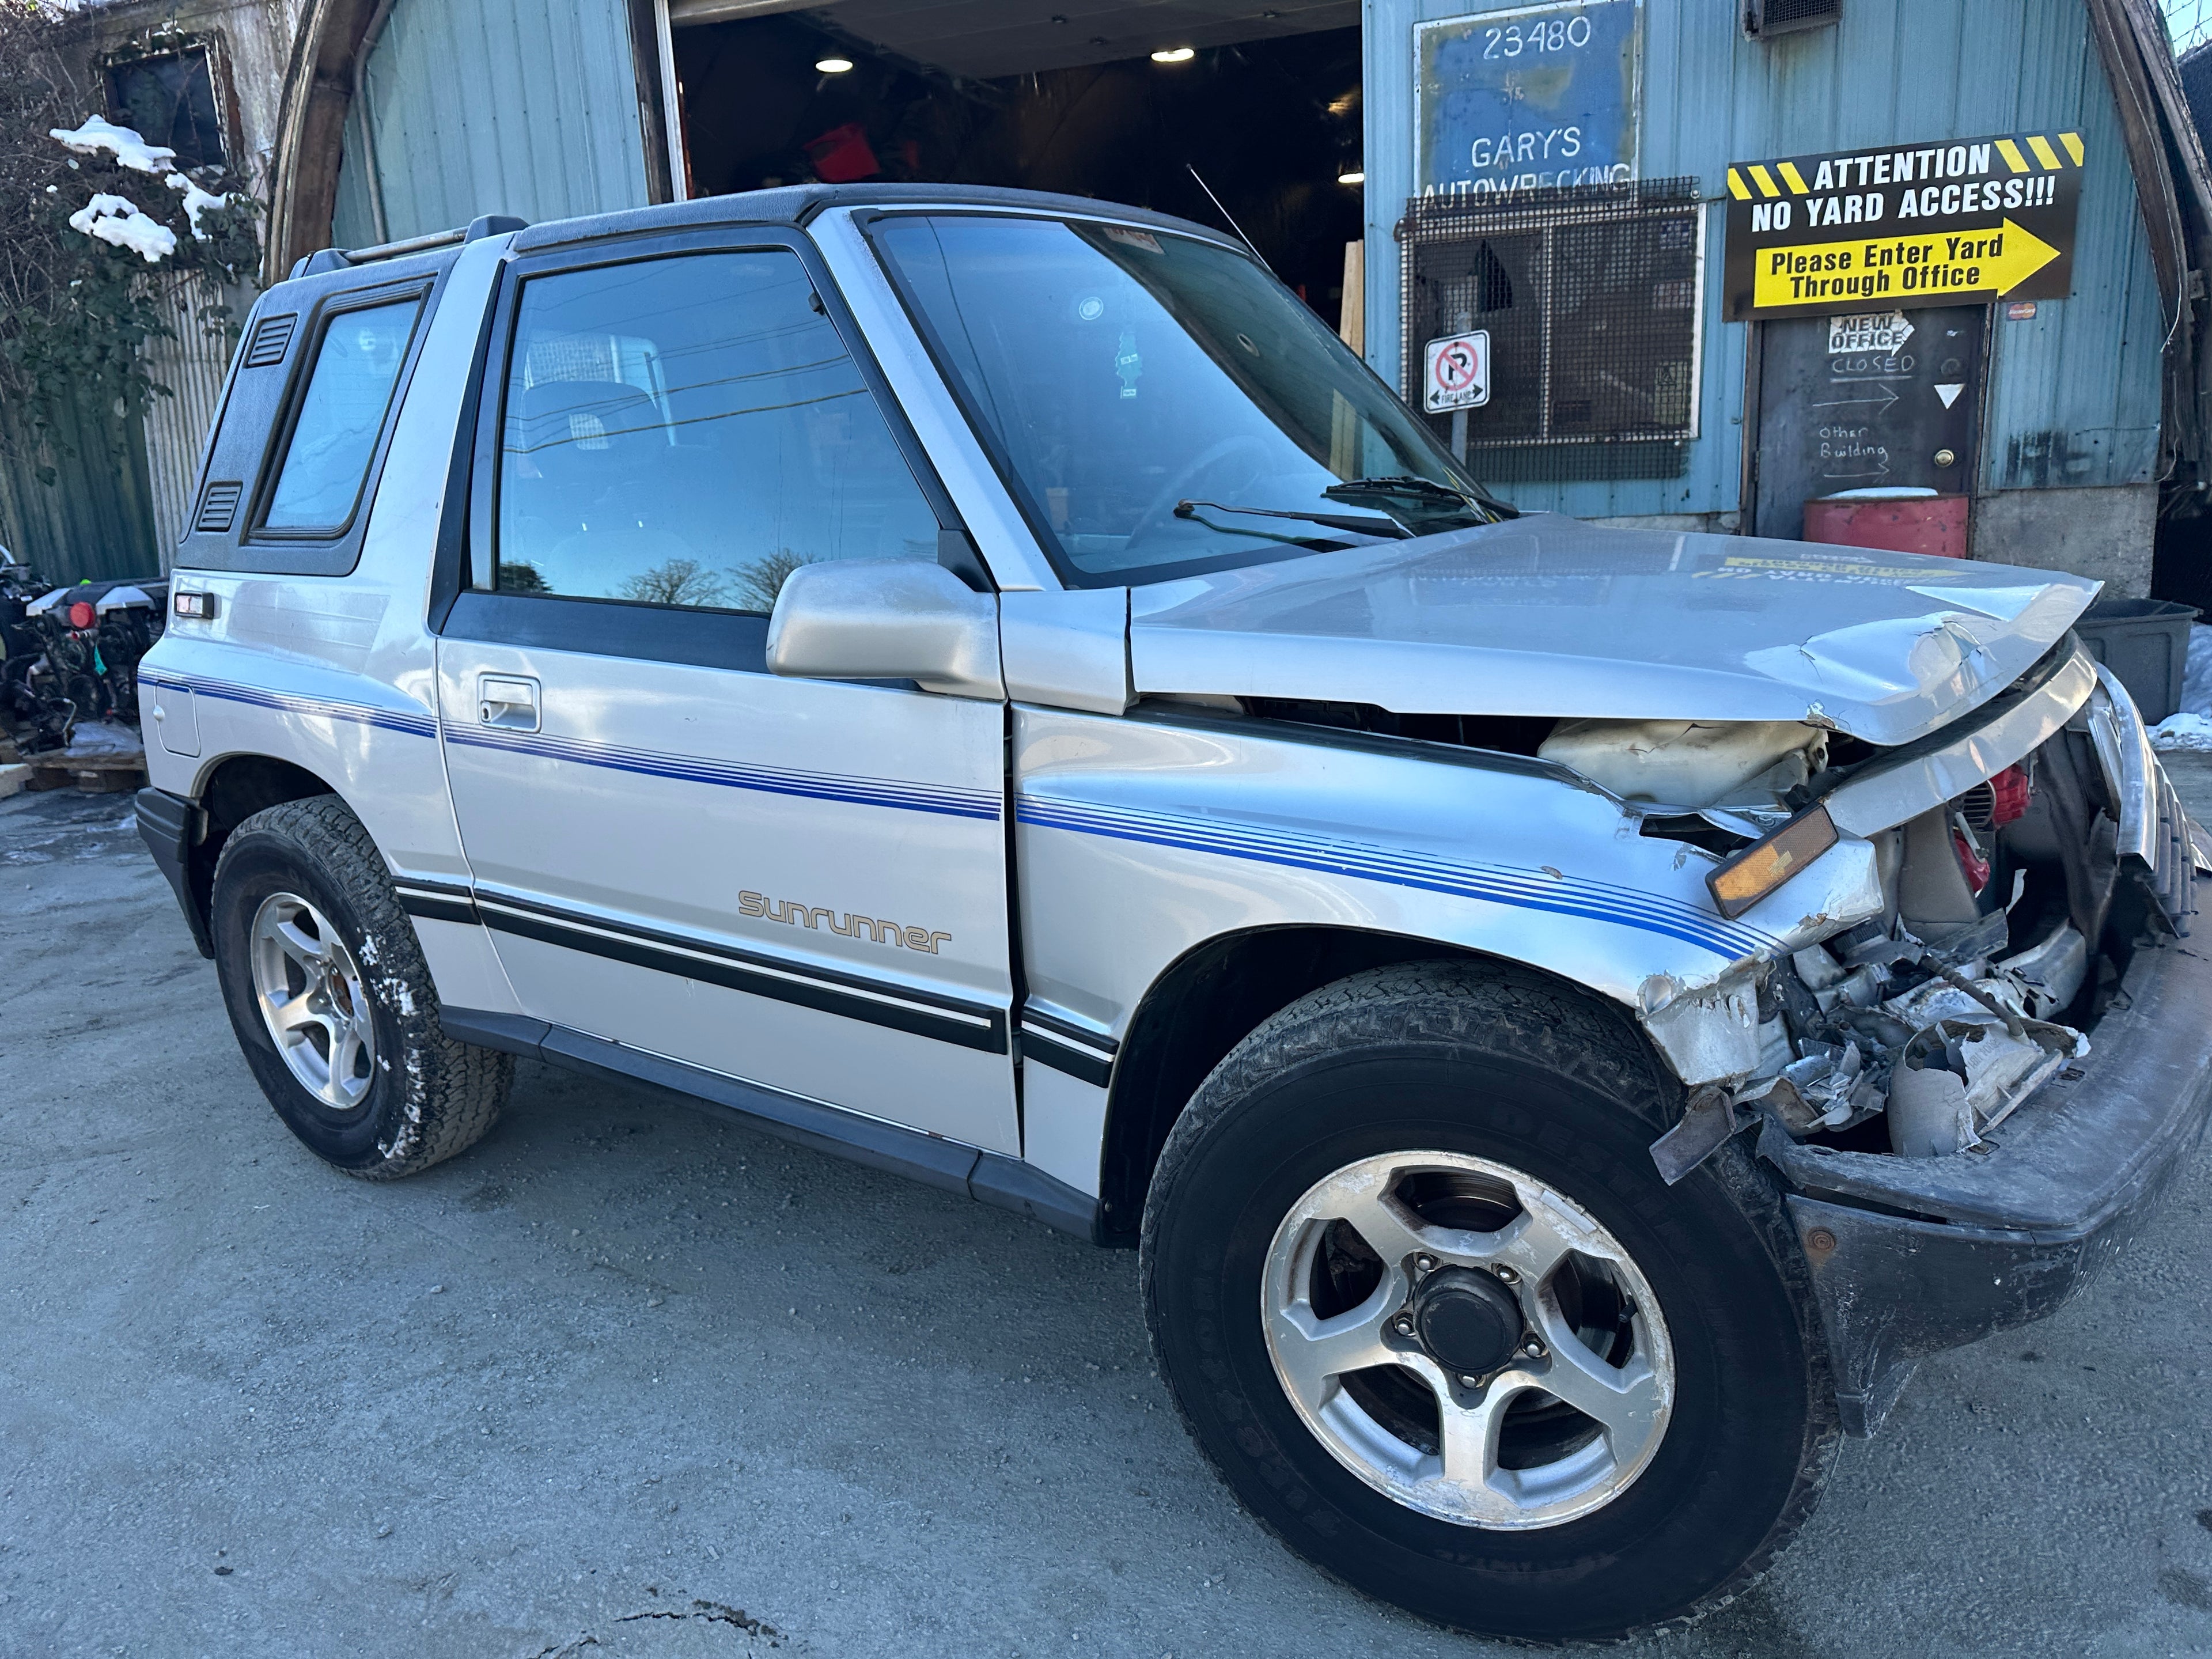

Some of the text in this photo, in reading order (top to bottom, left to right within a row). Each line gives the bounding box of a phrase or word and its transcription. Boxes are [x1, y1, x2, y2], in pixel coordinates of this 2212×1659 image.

[1483, 16, 1591, 59] 23480
[1472, 127, 1581, 166] GARY'S
[1813, 143, 1990, 191] ATTENTION
[1752, 176, 2055, 232] NO YARD ACCESS!!!
[1771, 233, 2003, 275] Please Enter Yard
[1790, 265, 1980, 298] Through Office
[1831, 331, 1903, 349] OFFICE
[1842, 316, 1893, 333] NEW
[1832, 355, 1914, 373] CLOSED
[738, 890, 952, 955] Sunrunner
